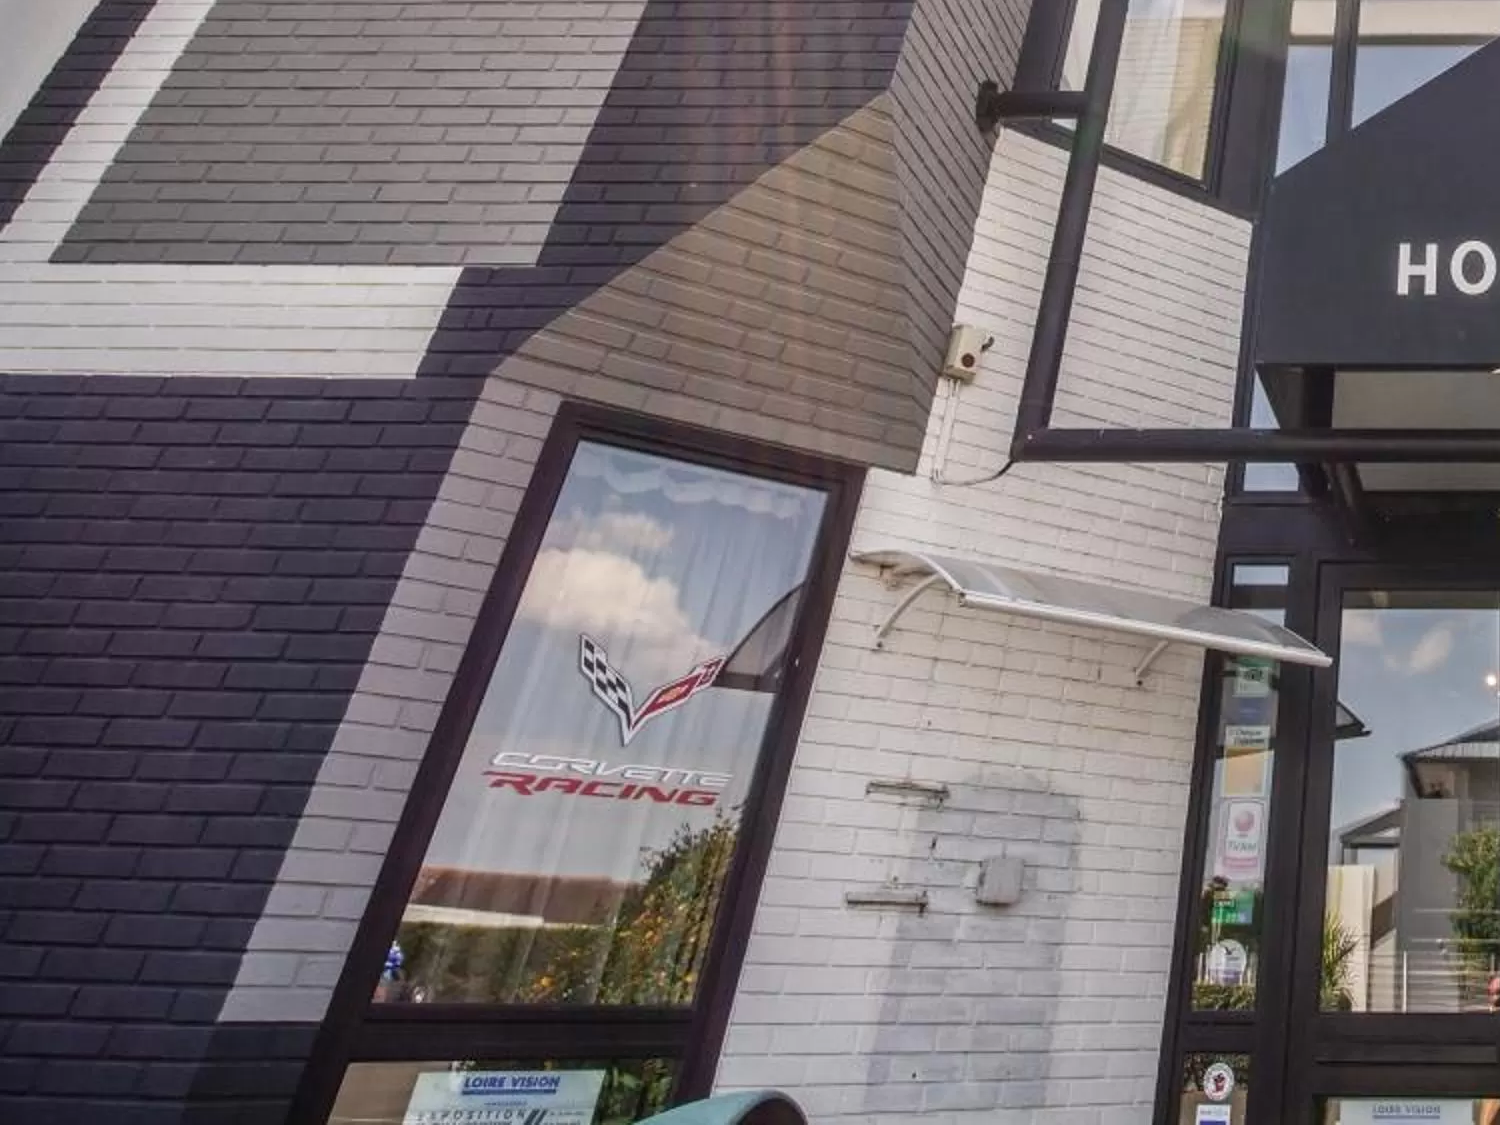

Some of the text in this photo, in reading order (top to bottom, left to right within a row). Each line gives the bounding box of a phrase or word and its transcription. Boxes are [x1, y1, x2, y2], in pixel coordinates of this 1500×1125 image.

[491, 751, 734, 787] CORVETTE
[481, 770, 721, 806] RACING
[511, 1075, 561, 1088] VISION
